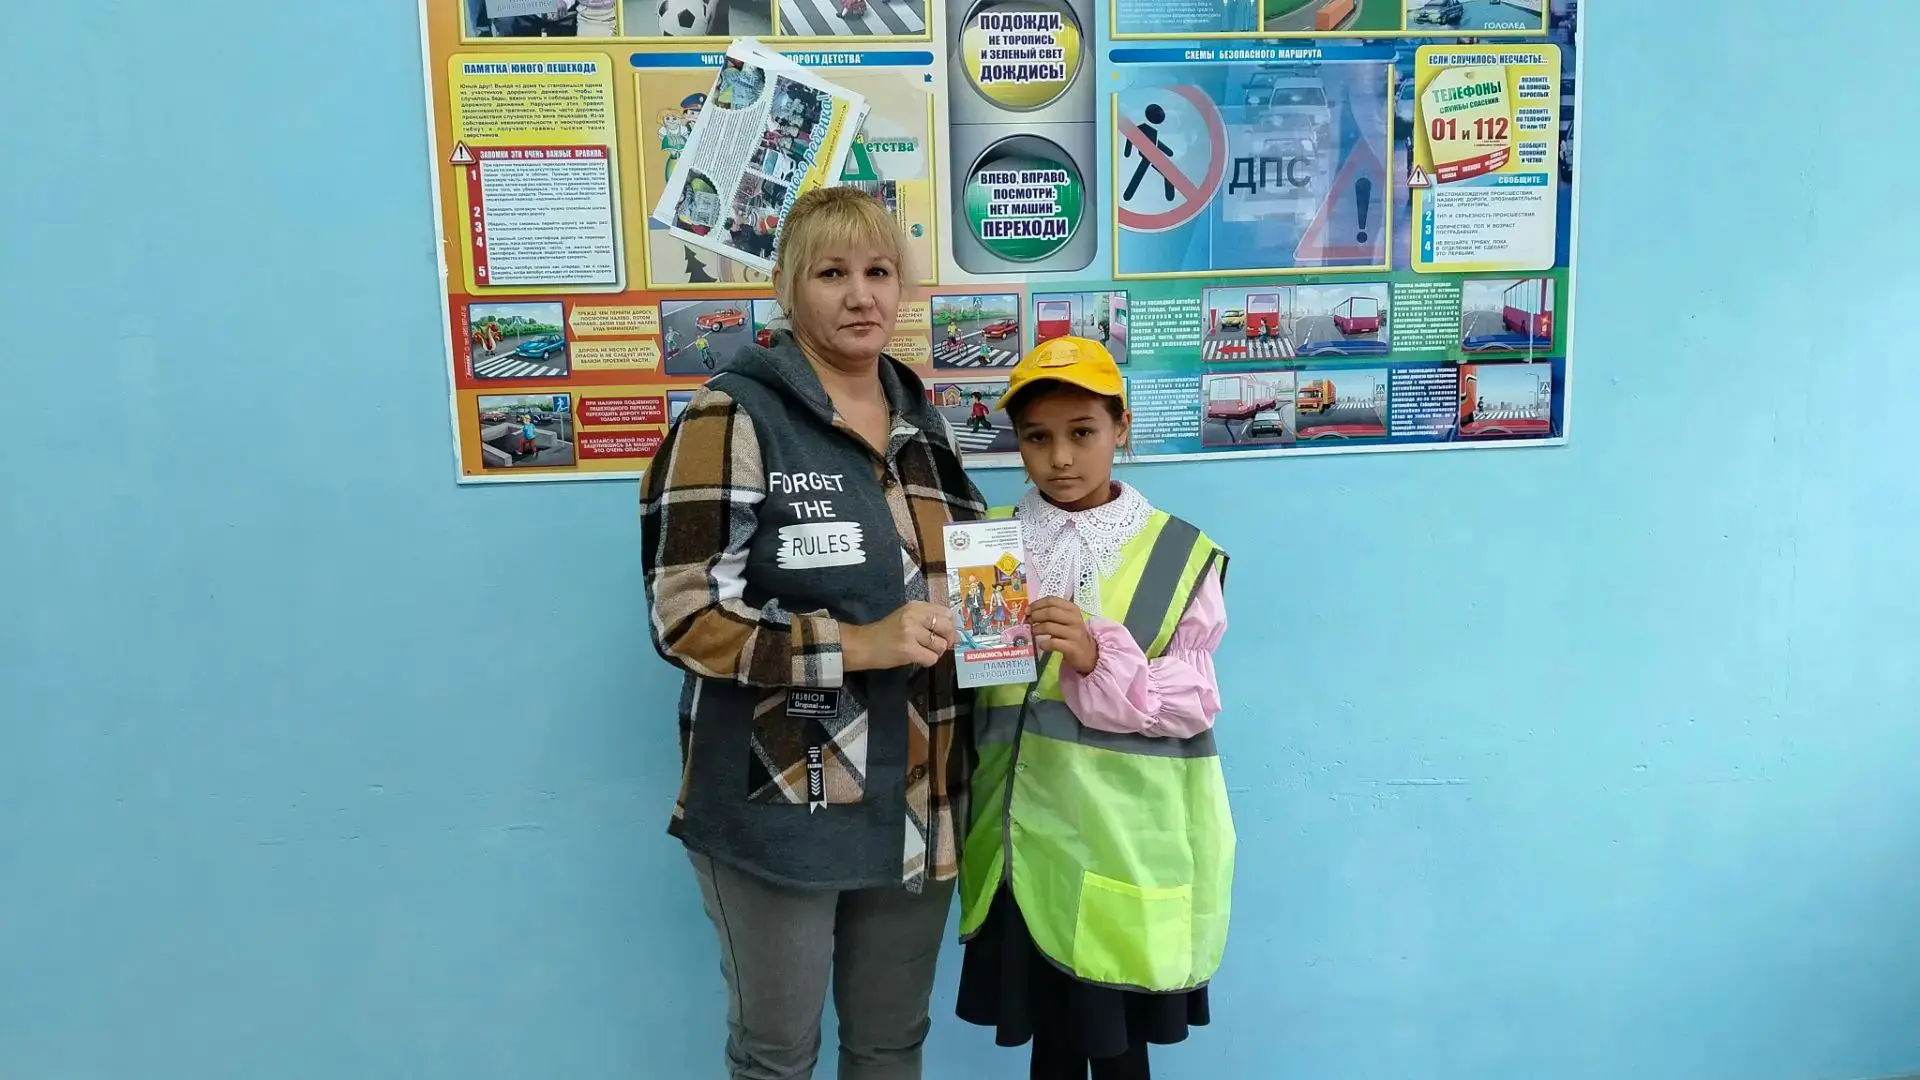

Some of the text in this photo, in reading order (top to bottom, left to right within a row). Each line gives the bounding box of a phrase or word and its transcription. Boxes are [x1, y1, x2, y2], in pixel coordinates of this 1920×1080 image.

[980, 14, 1062, 31] ПОДОЖДИ,
[989, 35, 1054, 45] НЕ ТОРОПИСЬ
[981, 48, 1063, 59] И ЗЕЛЕНЫЙ СВЕТ
[1185, 49, 1322, 60] СХЕМЫ БЕЗОПАСНОГО МАРШРУТА
[1429, 55, 1448, 64] ЕСЛИ
[1451, 55, 1497, 64] СЛУЧИЛОСЬ
[464, 63, 597, 74] ПАМЯТКА ЮНОГО ПЕШЕХОДА
[981, 64, 1064, 82] ДОЖДИСЬ!
[1432, 81, 1502, 103] ТЕЛЕФОНЫ
[1440, 97, 1499, 113] СЛУЖБЫ СПАСЕНИЯ
[1431, 117, 1509, 141] 01 и 112
[480, 150, 509, 159] ЗАПОМНИ
[511, 150, 522, 158] ЭТИ
[525, 150, 544, 158] ОЧЕНЬ
[472, 170, 477, 180] 1
[980, 172, 1068, 185] ВЛЕВО, ВПРАВО,
[1229, 156, 1312, 194] ДПС
[994, 188, 1056, 200] ПОСМОТРИ:
[473, 207, 480, 217] 2
[990, 204, 1009, 215] НЕТ
[1012, 203, 1053, 214] МАШИН
[1425, 211, 1432, 221] 2
[475, 222, 482, 233] 3
[984, 219, 1066, 237] ПЕРЕХОДИ
[1425, 225, 1432, 235] 3
[476, 237, 483, 248] 4
[1424, 241, 1431, 251] 4
[478, 266, 485, 277] 5
[769, 472, 844, 494] FORGET
[788, 500, 836, 519] THE
[792, 534, 851, 557] RULES
[967, 651, 1002, 660] БЕЗОПАСНОСТЬ
[984, 660, 1030, 670] ПАМЯТКА
